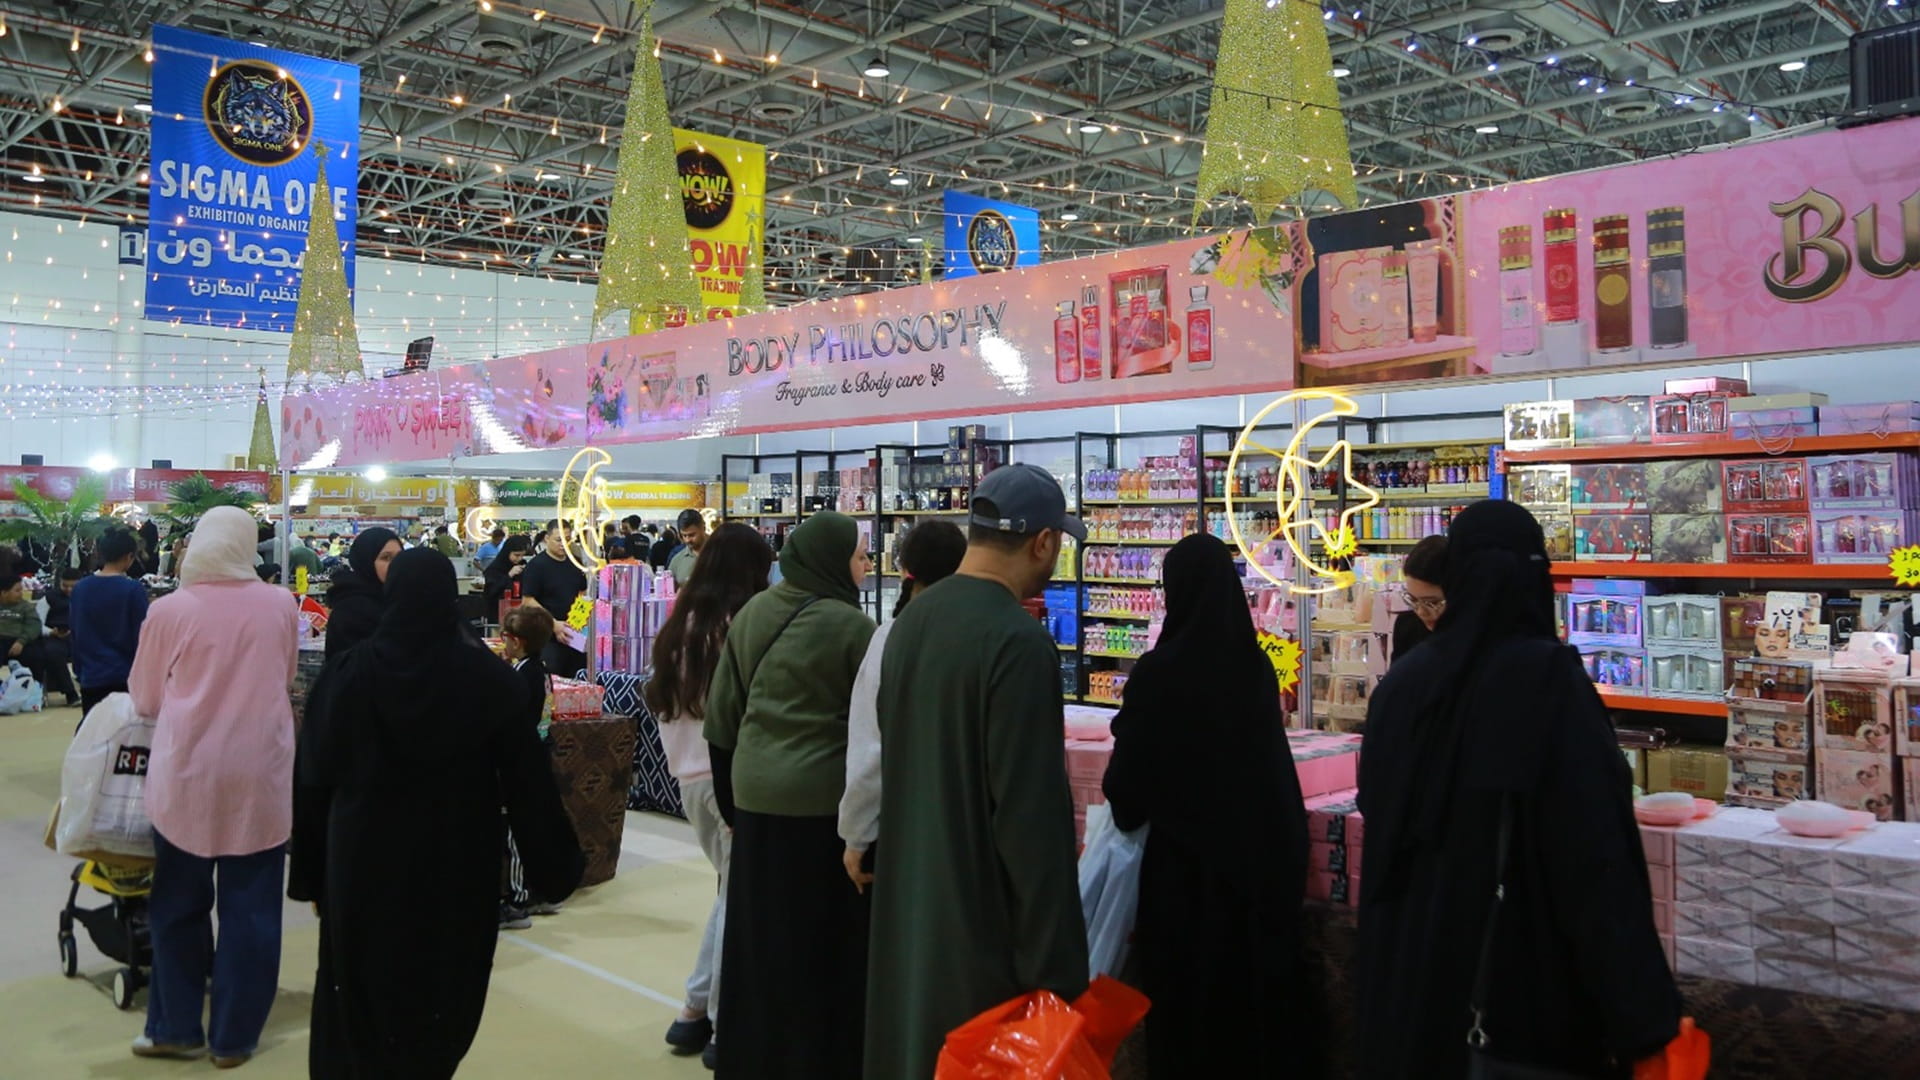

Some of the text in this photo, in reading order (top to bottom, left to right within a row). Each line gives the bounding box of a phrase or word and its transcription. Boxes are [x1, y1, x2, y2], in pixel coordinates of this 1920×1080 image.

[233, 137, 284, 152] SIGMA ONE
[159, 160, 273, 211] SIGMA
[188, 205, 254, 226] EXHIBITION
[157, 229, 212, 268] ون
[727, 301, 1007, 376] BODY PHILOSOPHY
[776, 371, 926, 407] Fragrance & Body care
